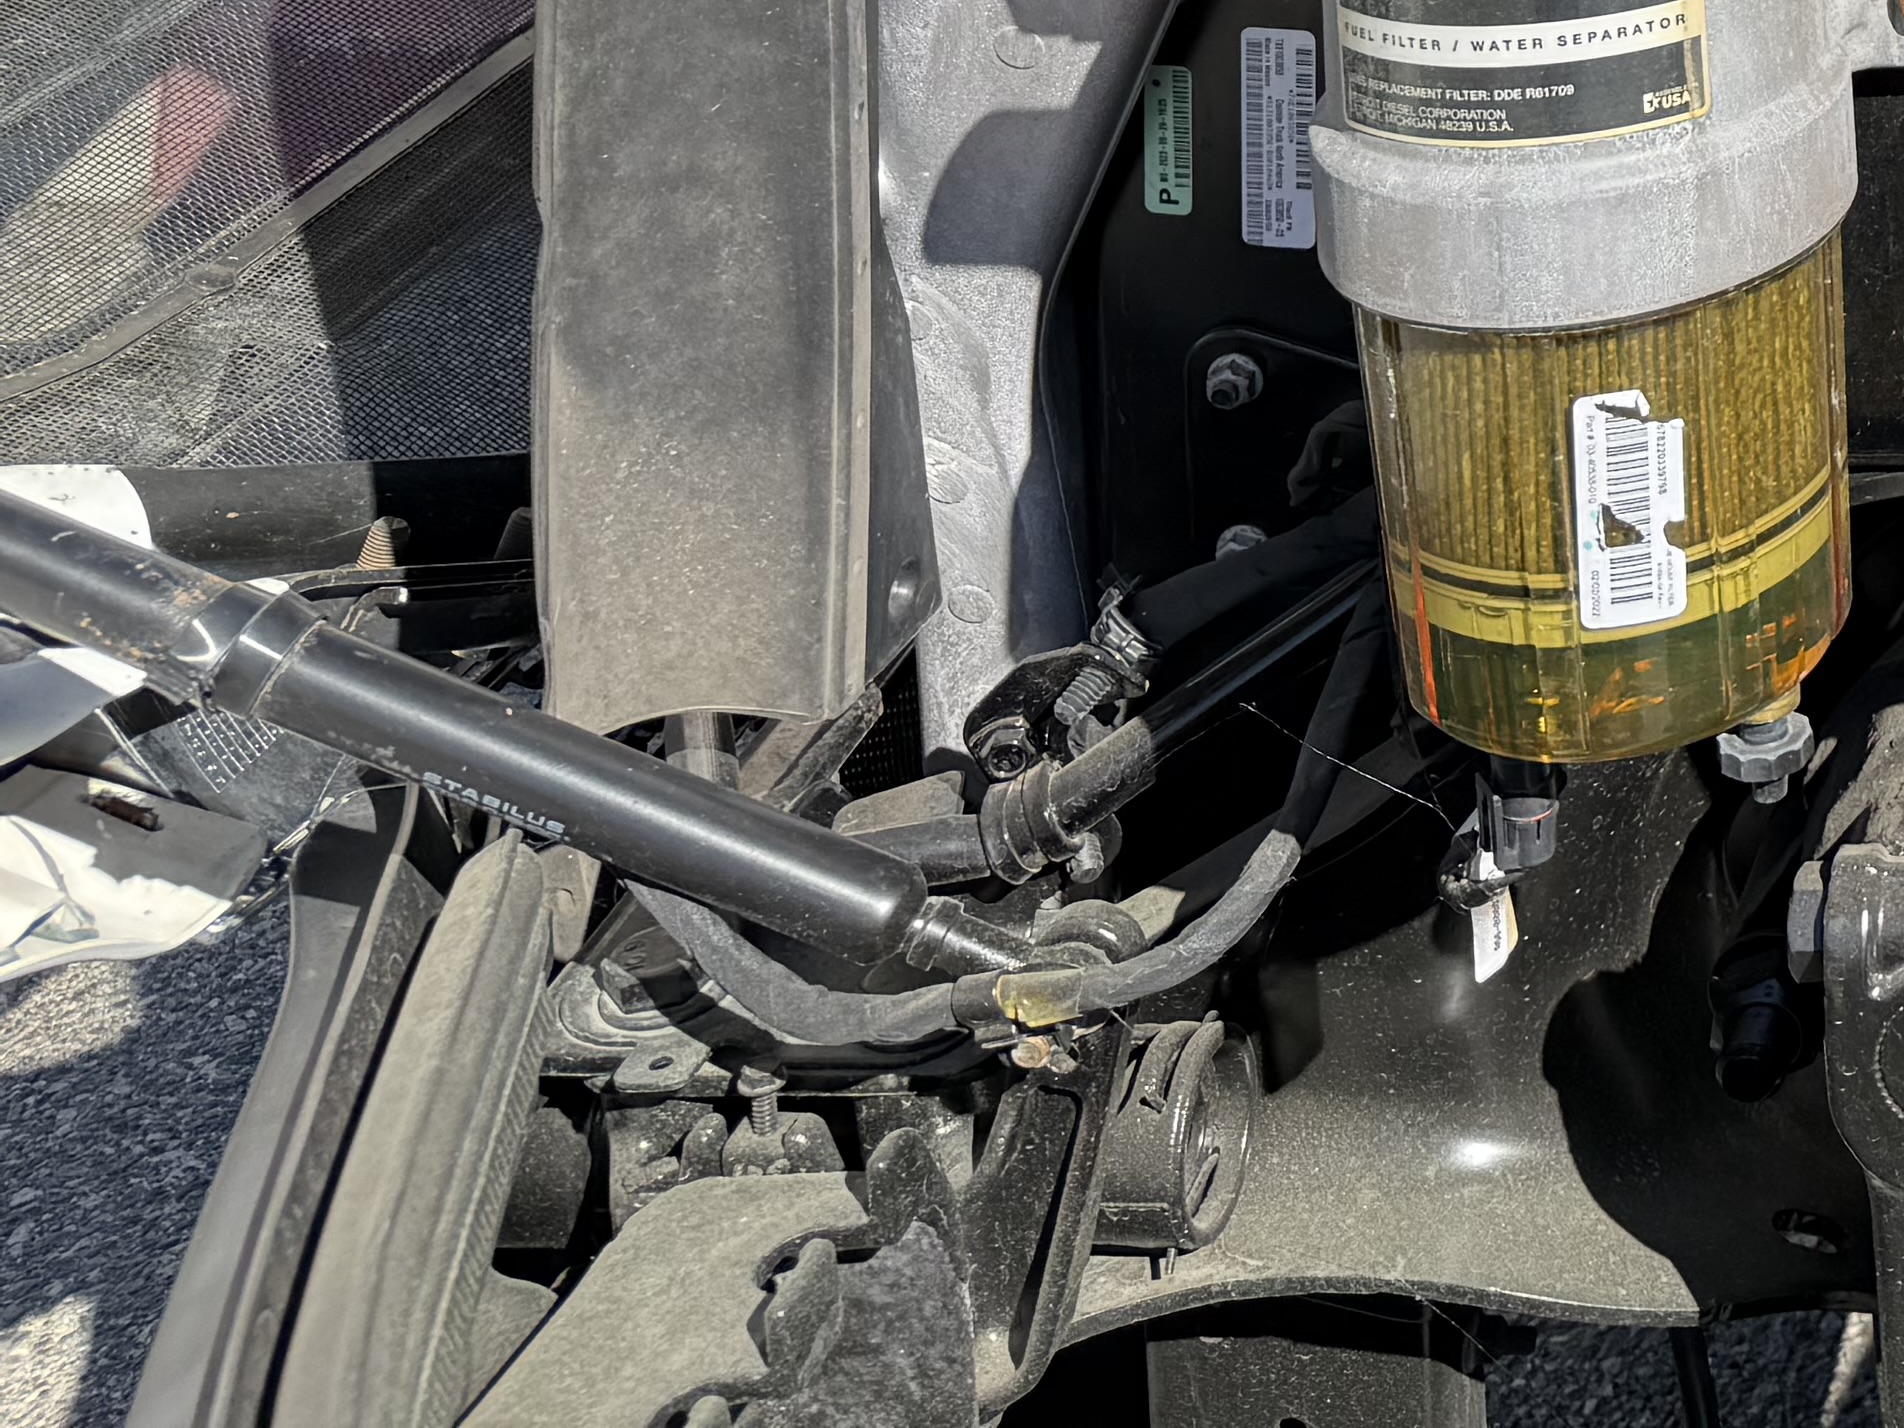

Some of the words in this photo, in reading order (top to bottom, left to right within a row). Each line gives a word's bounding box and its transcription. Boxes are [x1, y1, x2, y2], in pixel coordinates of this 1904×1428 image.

[1344, 21, 1375, 42] FUEL
[1382, 32, 1441, 52] FILTER
[1452, 39, 1459, 52] /
[1471, 38, 1544, 52] WATER
[1557, 13, 1687, 47] SEPARATOR
[1367, 78, 1442, 100] REPLACEMENT
[1446, 88, 1491, 101] FILTER:
[1494, 87, 1522, 101] DDE
[1661, 90, 1691, 109] USA
[1382, 100, 1417, 117] DIESEL
[1418, 105, 1507, 121] CORPORATION
[1385, 110, 1437, 131] MICHIGAN
[1438, 118, 1474, 132] 48239
[1476, 120, 1514, 133] U.S.A.
[1159, 187, 1180, 206] P
[420, 769, 568, 836] STABILUS
